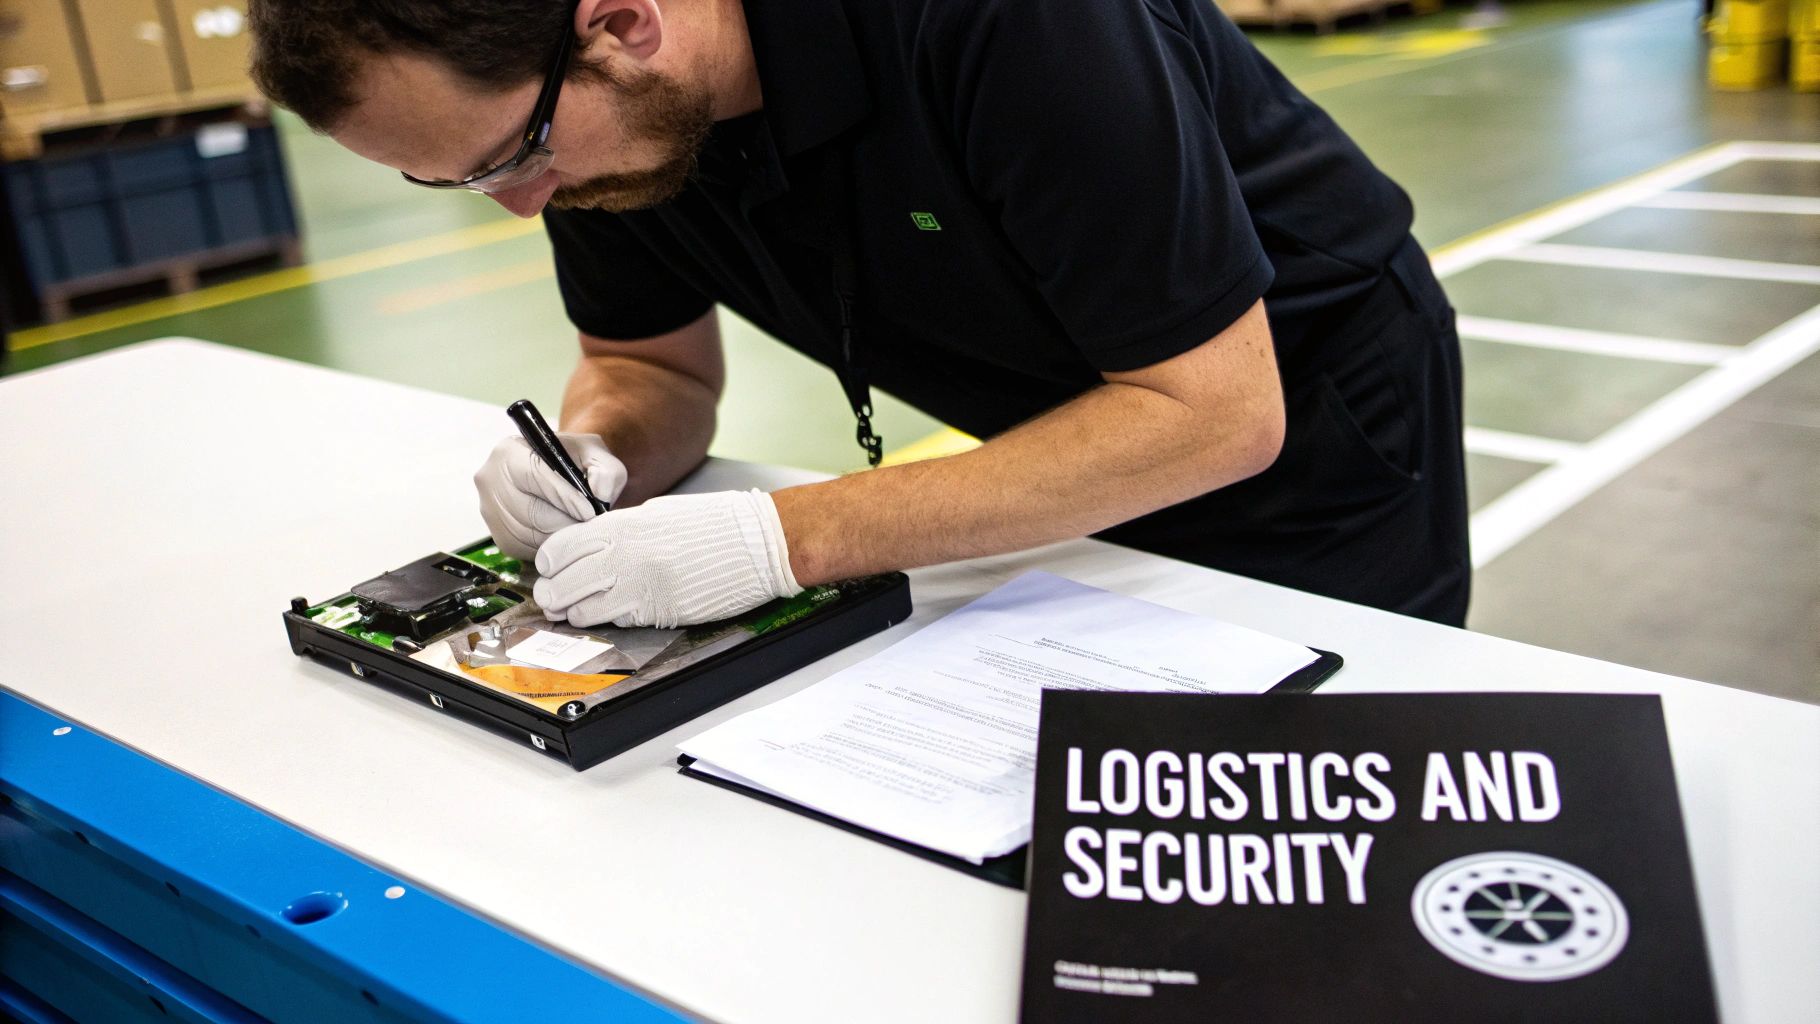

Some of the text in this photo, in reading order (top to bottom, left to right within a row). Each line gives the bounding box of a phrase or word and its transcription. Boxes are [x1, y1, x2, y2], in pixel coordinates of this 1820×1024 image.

[1066, 747, 1396, 822] LOGISTICS
[1420, 750, 1561, 822] AND
[1062, 826, 1374, 906] SECURITY
